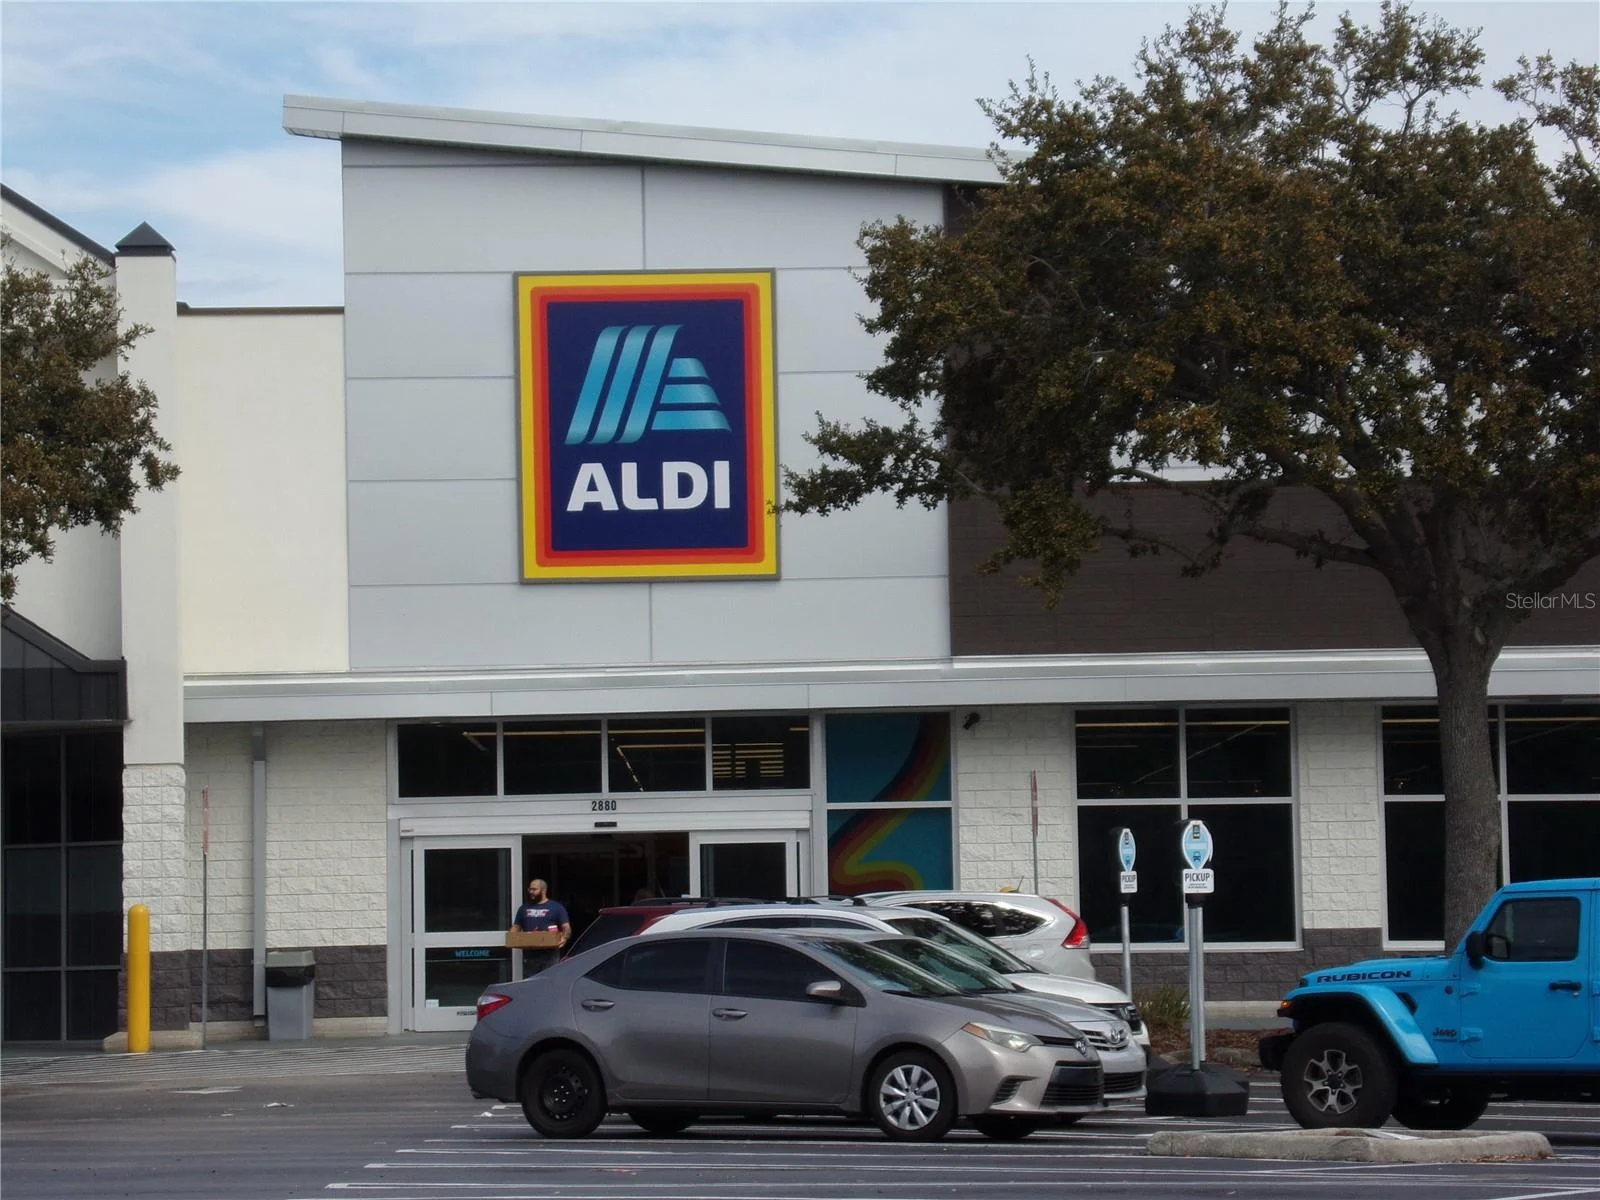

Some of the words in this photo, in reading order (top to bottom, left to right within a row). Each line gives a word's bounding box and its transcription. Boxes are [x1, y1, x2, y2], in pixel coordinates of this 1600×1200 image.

[566, 460, 731, 511] ALDI
[592, 800, 617, 811] 2880
[1185, 872, 1211, 882] PICKUP
[455, 949, 490, 957] WELCOME
[1316, 970, 1413, 983] RUBICON
[1432, 1027, 1457, 1038] Jeep
